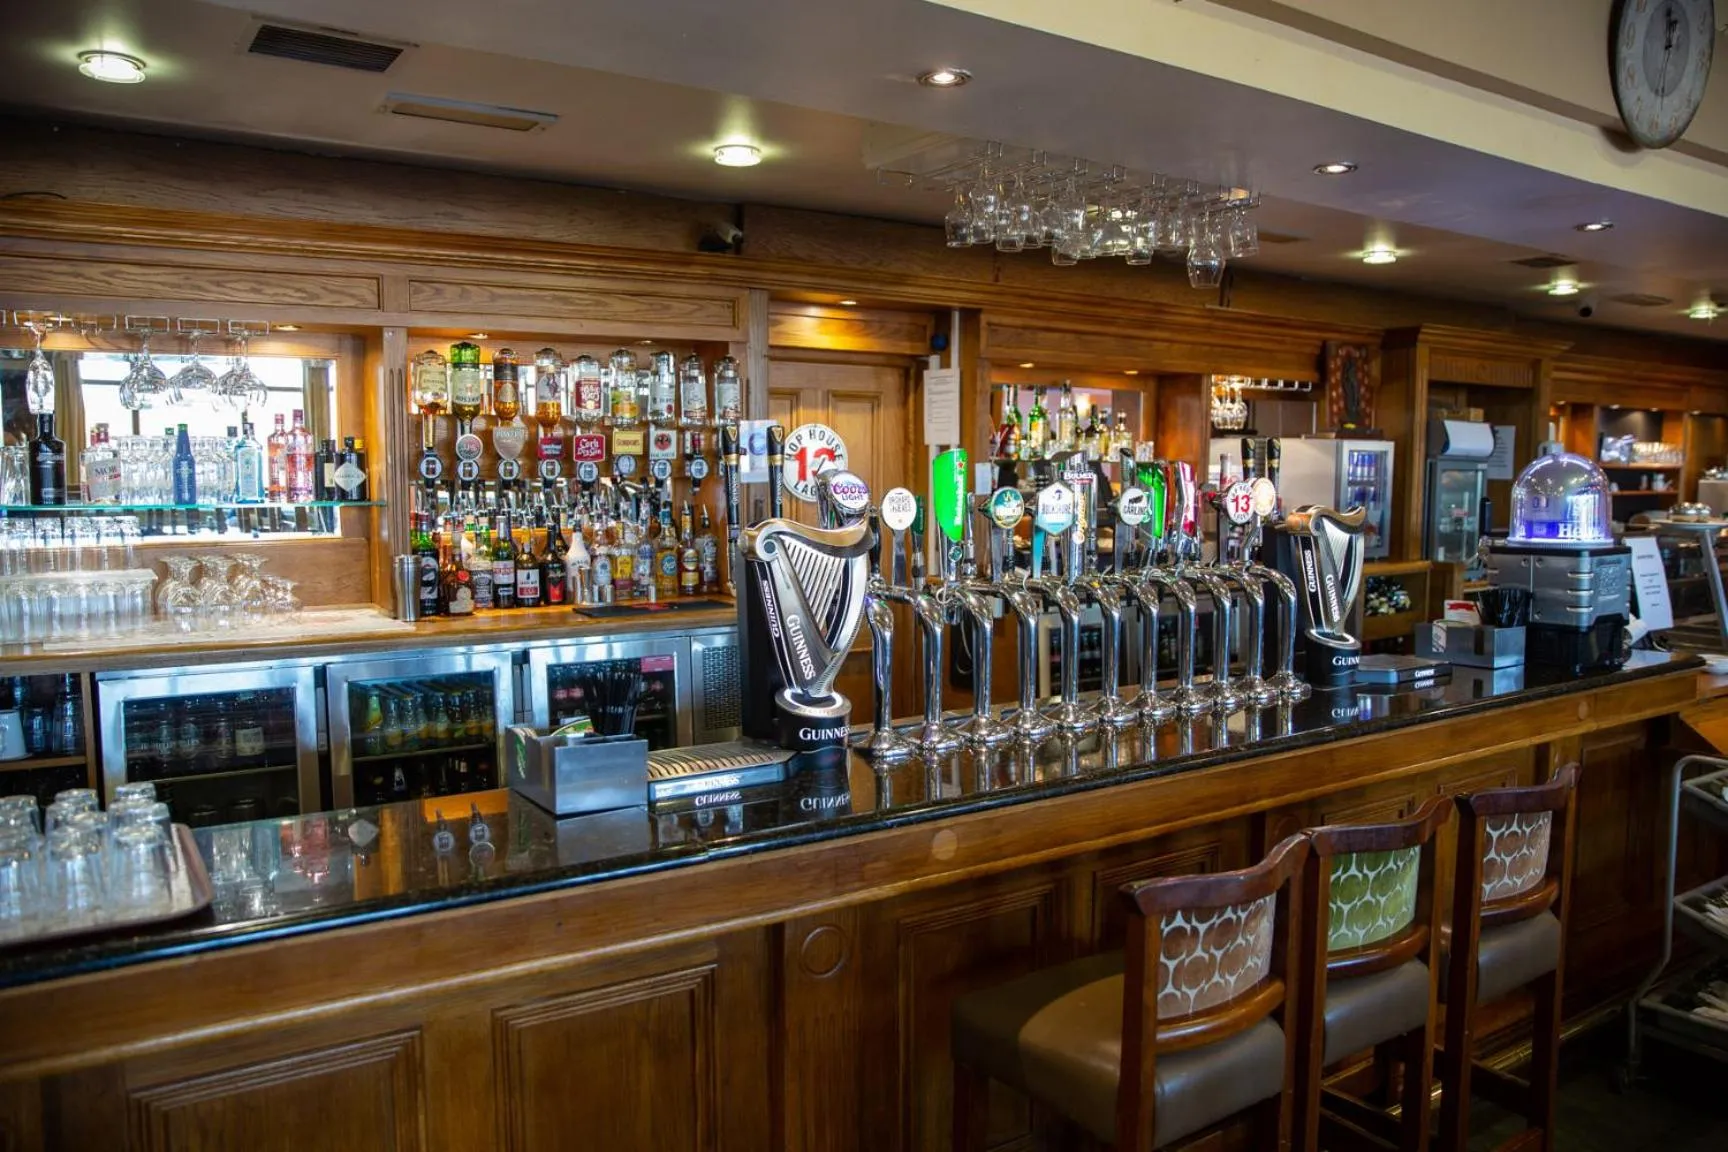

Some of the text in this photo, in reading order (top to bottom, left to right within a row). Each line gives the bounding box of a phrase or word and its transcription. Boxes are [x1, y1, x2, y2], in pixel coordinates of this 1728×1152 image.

[785, 433, 803, 460] HOP
[809, 429, 843, 460] HOUSE
[794, 483, 818, 496] LAG
[832, 482, 868, 495] Coors
[1233, 495, 1251, 513] 13
[1304, 548, 1317, 593] GUINNESS
[762, 580, 780, 639] GUINNESS
[1325, 573, 1341, 623] GUINNESS
[786, 614, 816, 680] GUINNESS
[799, 727, 850, 741] GUINNES
